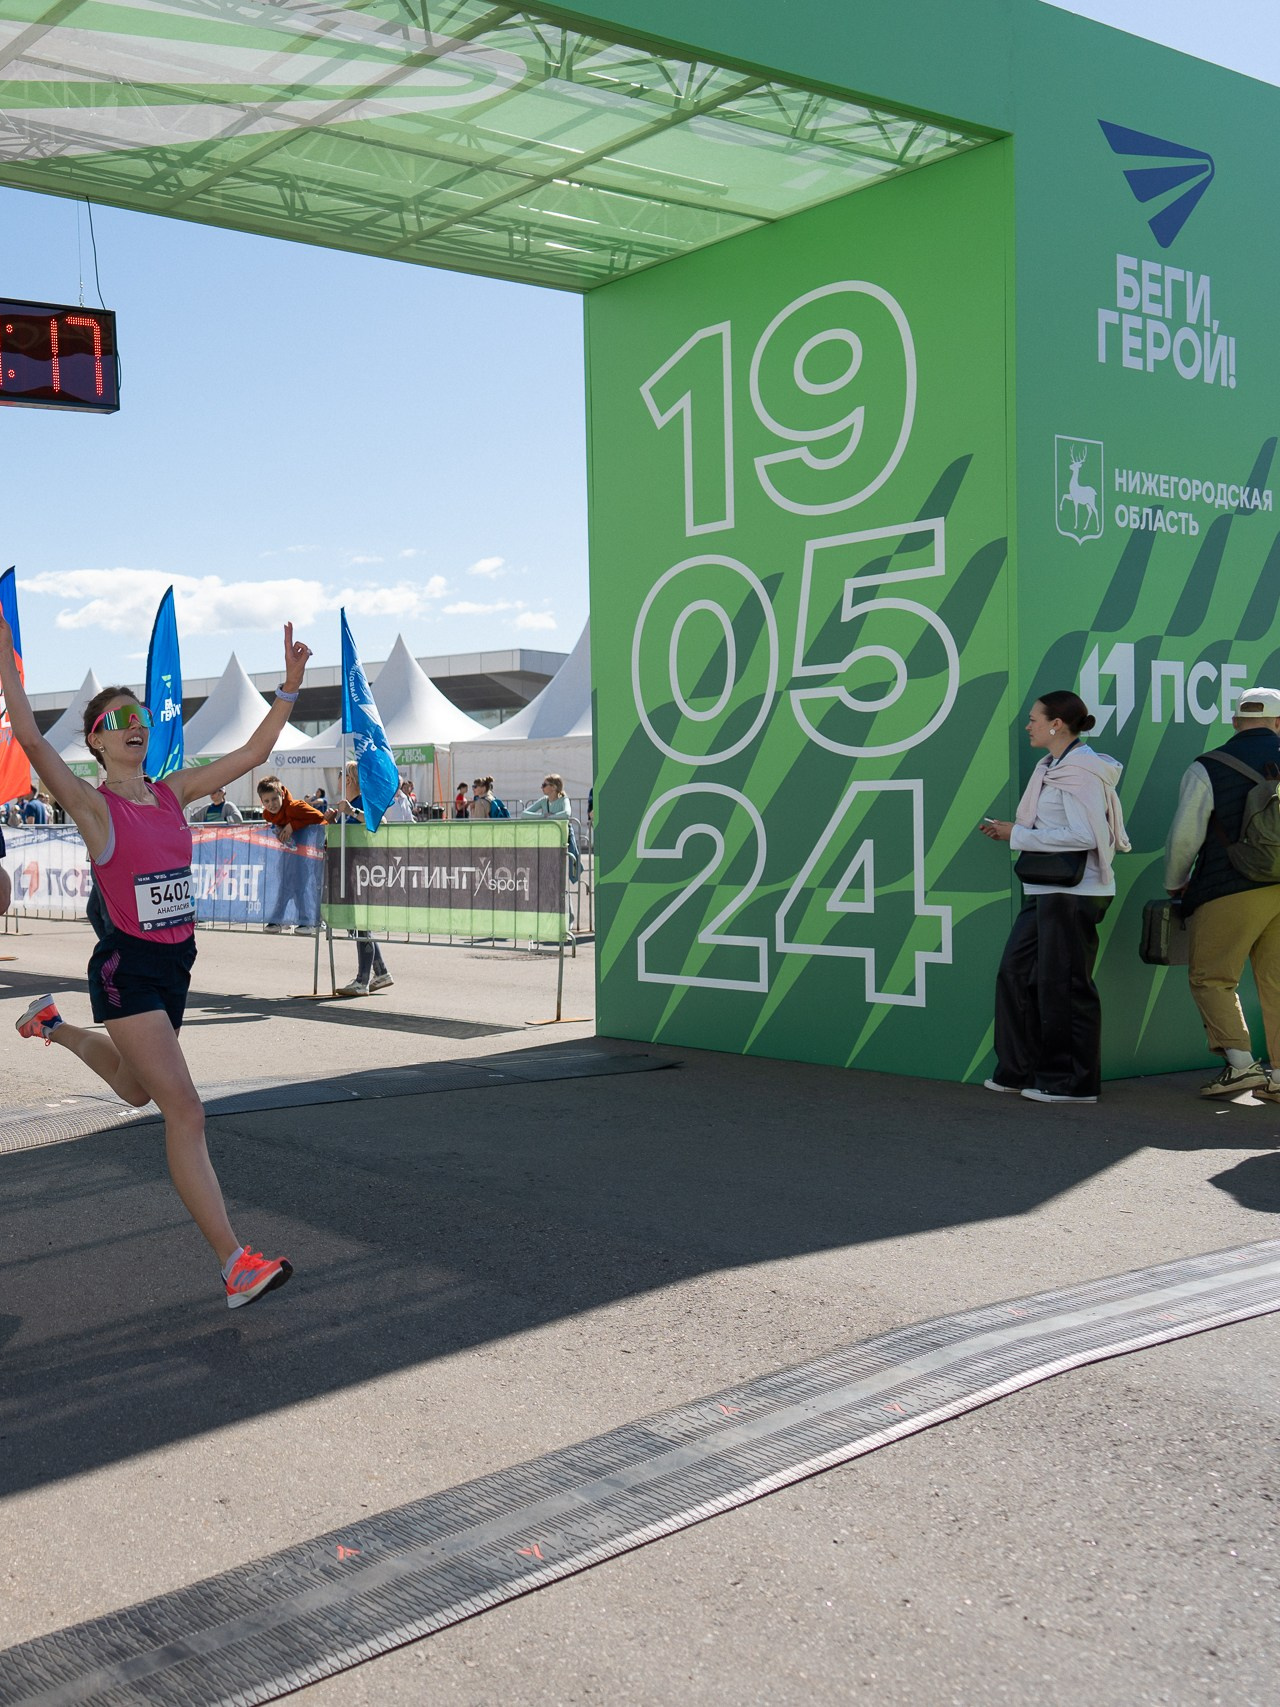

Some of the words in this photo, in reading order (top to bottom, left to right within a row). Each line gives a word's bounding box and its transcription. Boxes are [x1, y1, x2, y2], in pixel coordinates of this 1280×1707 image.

[1116, 253, 1220, 335] БЕГИ,
[1097, 308, 1237, 389] ГЕРОЙ!
[639, 279, 918, 538] 19
[1114, 468, 1273, 512] НИЖЕГОРОДСКАЯ
[1114, 503, 1200, 537] ОБЛАСТЬ
[631, 516, 960, 766] 05
[287, 755, 317, 765] СОРДИС
[150, 880, 191, 905] 5402
[488, 876, 530, 895] sport
[637, 779, 953, 1008] 24
[157, 902, 190, 915] АНАСТАСИЯ
